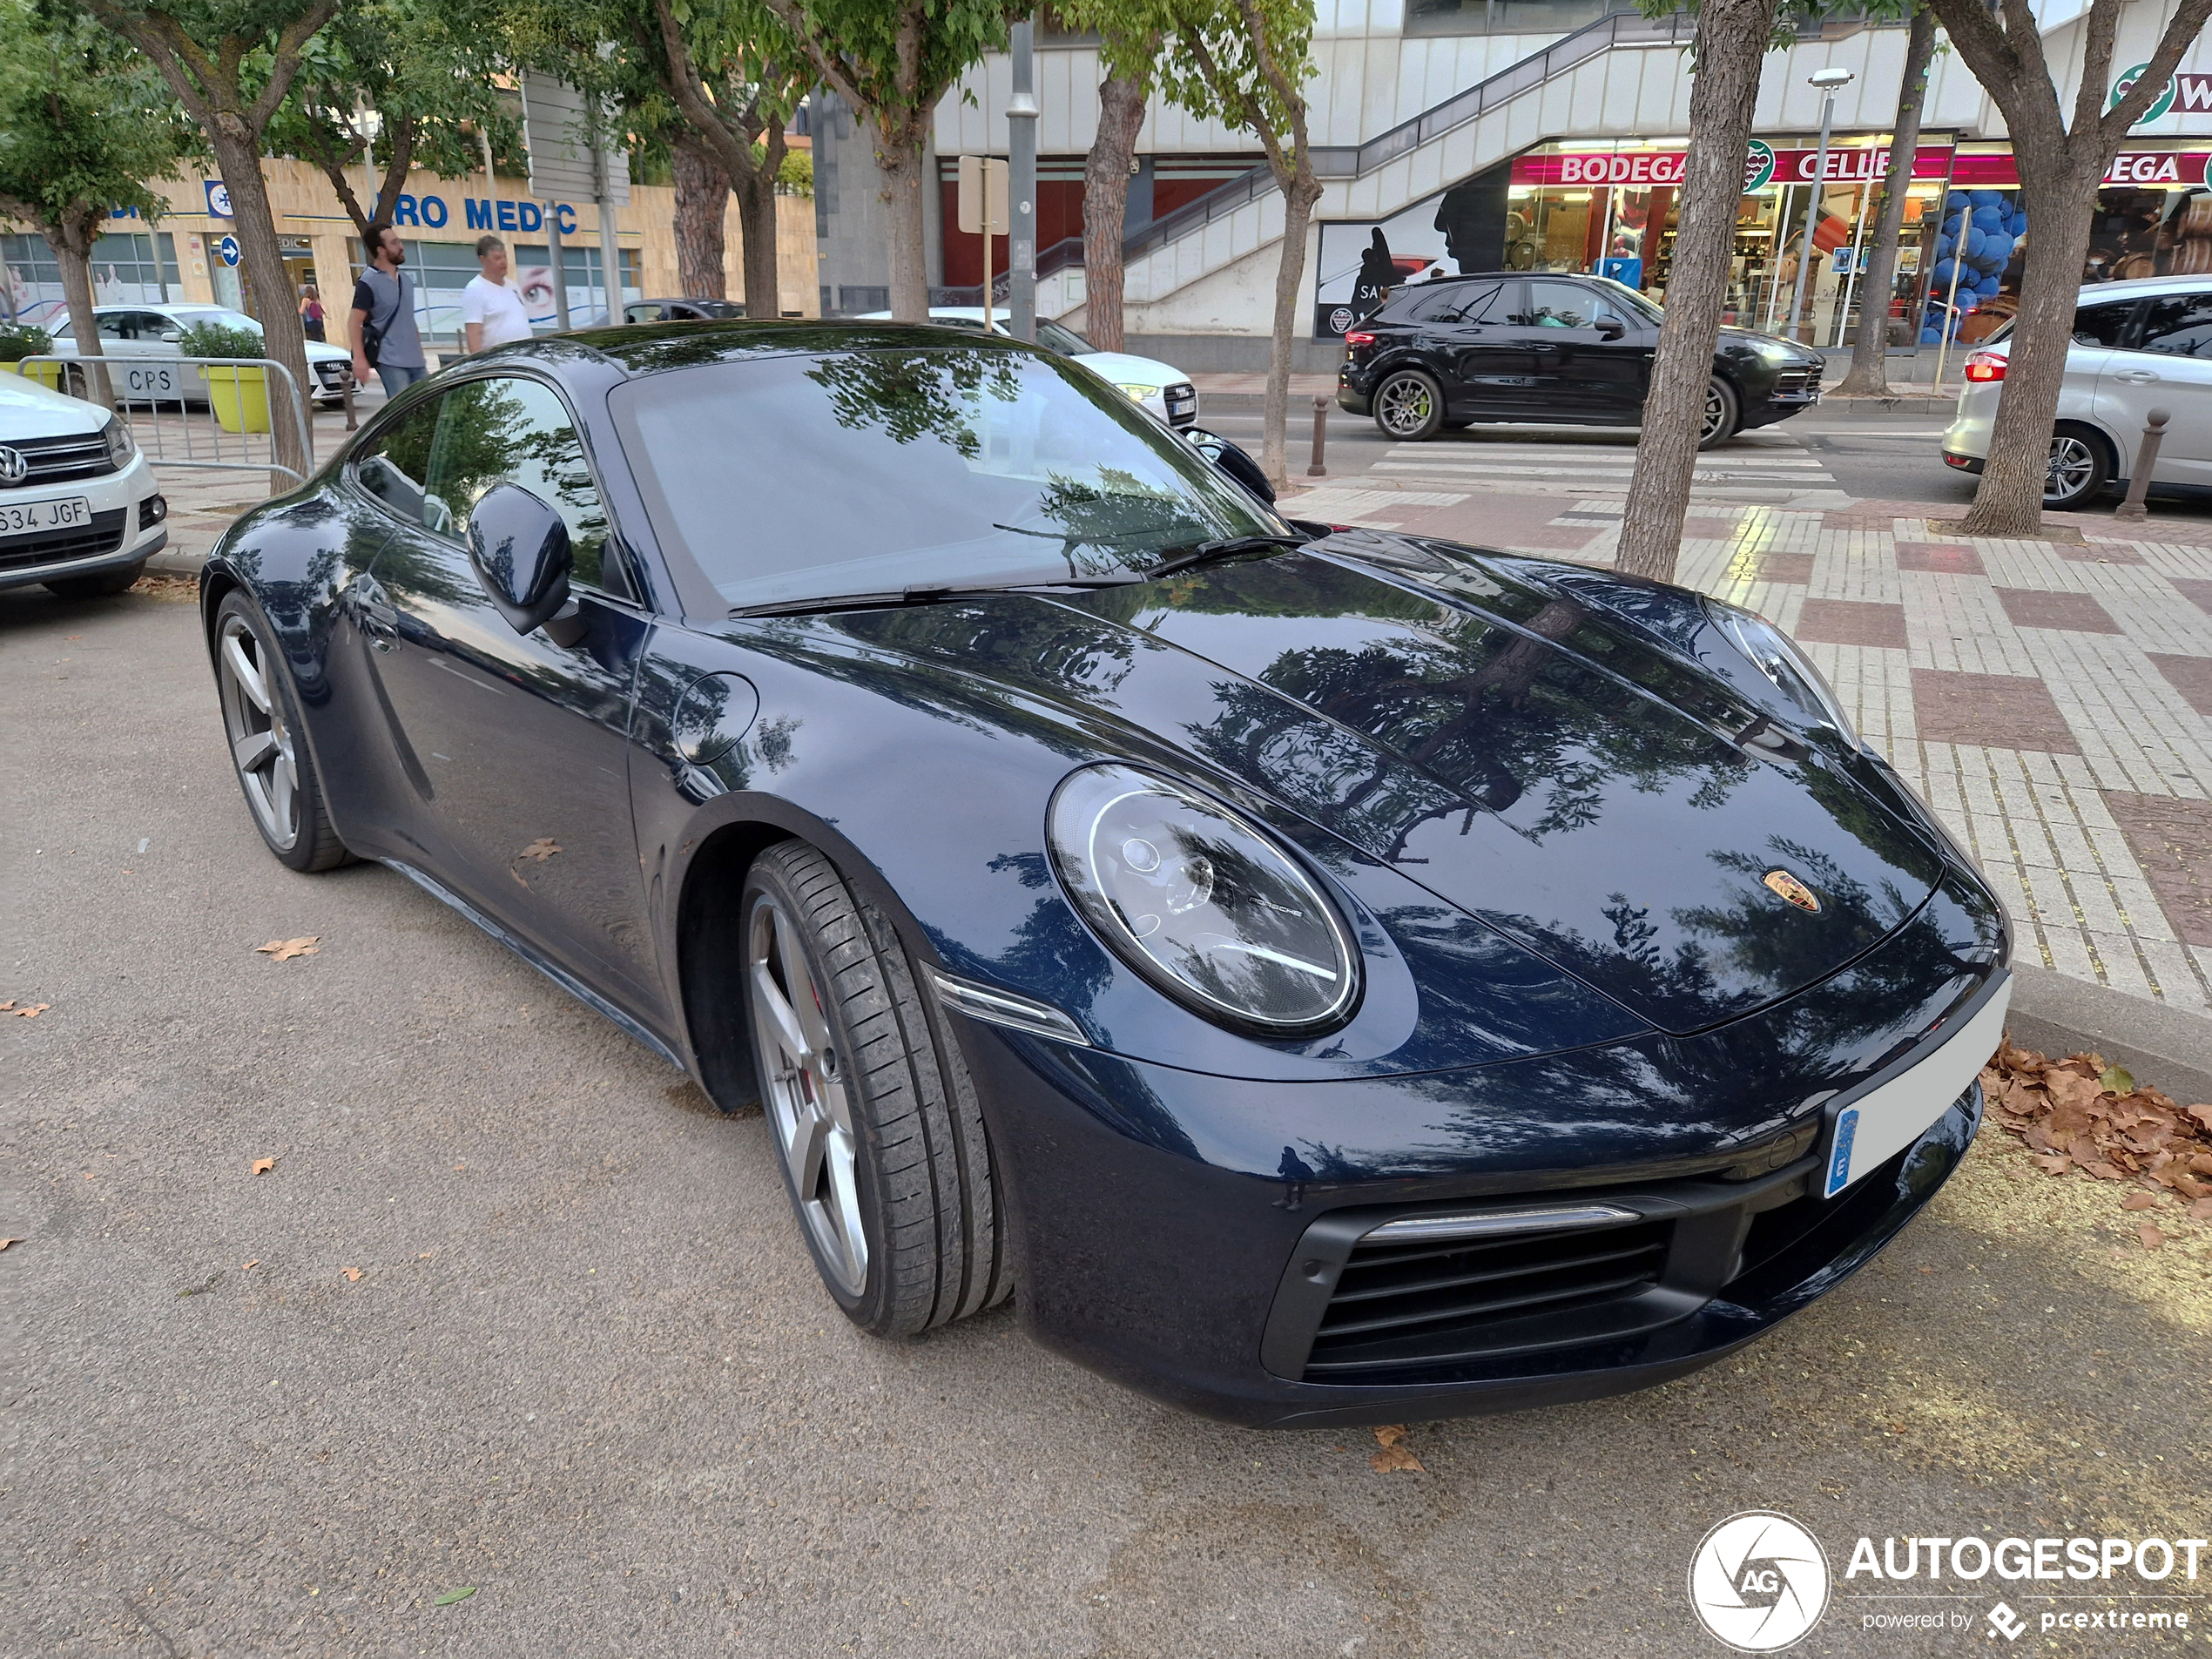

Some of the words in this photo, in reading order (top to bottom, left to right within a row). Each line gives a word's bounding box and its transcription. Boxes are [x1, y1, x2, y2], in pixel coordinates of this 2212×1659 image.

[1798, 152, 1918, 179] CELLE
[2103, 156, 2179, 181] EGA
[464, 198, 577, 234] MEDC
[1360, 285, 1385, 299] SA
[130, 370, 171, 390] CPS
[49, 502, 83, 525] JGF
[1249, 896, 1304, 918] PORSCHE
[1836, 1157, 1845, 1177] E
